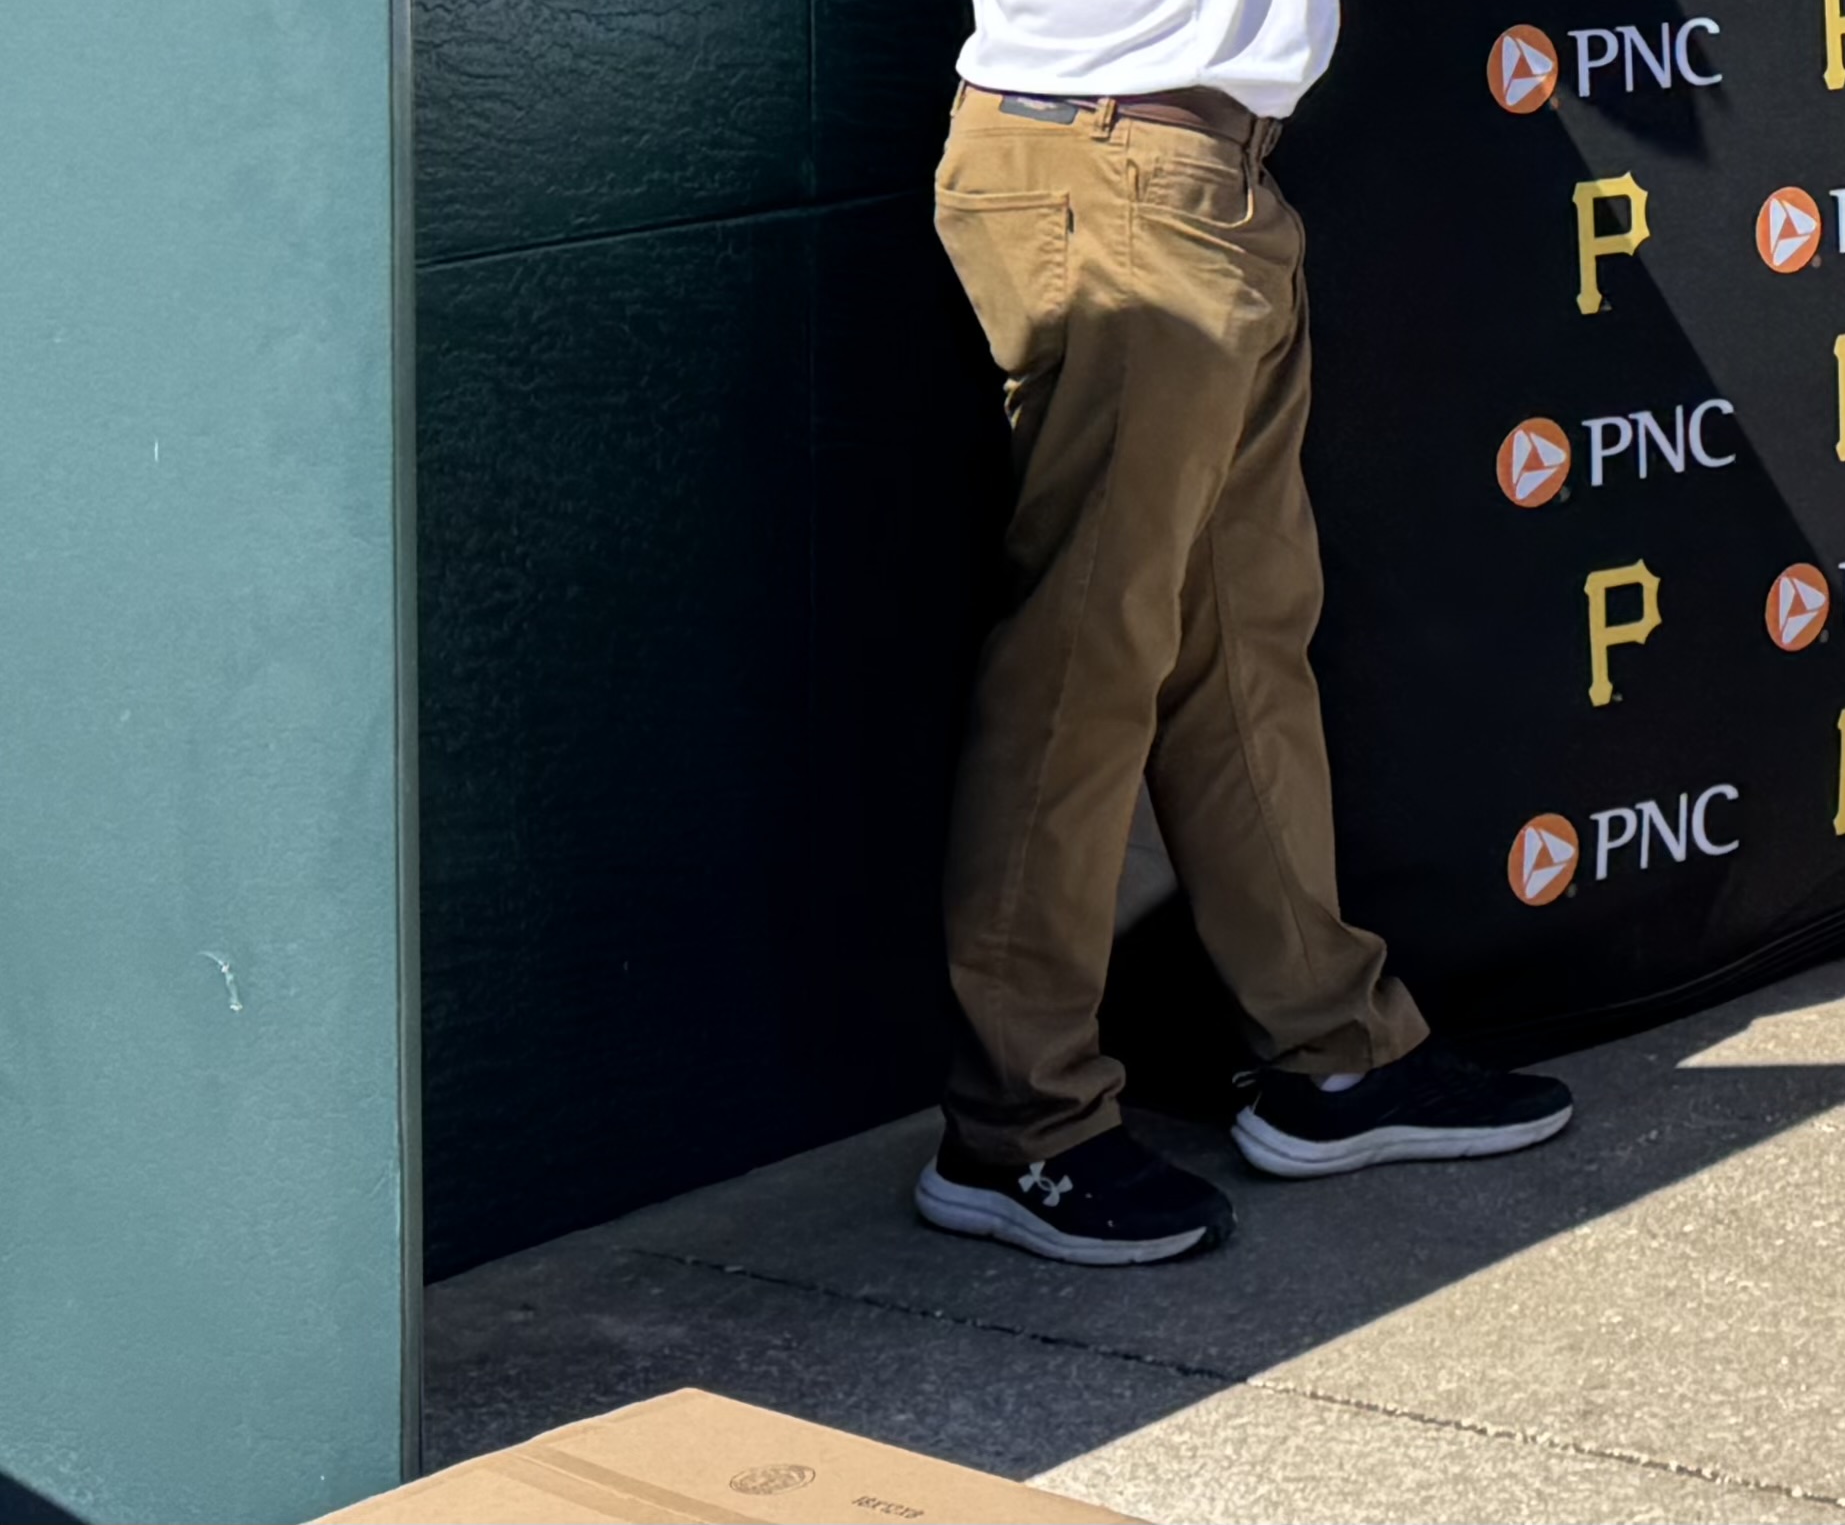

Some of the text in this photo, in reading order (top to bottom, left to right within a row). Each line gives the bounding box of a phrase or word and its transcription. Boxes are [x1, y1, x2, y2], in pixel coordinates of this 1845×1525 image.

[1567, 17, 1723, 97] PNC
[1573, 172, 1651, 315] P
[1581, 398, 1736, 486] PNC
[1584, 559, 1661, 707] P
[1590, 783, 1740, 881] PNC
